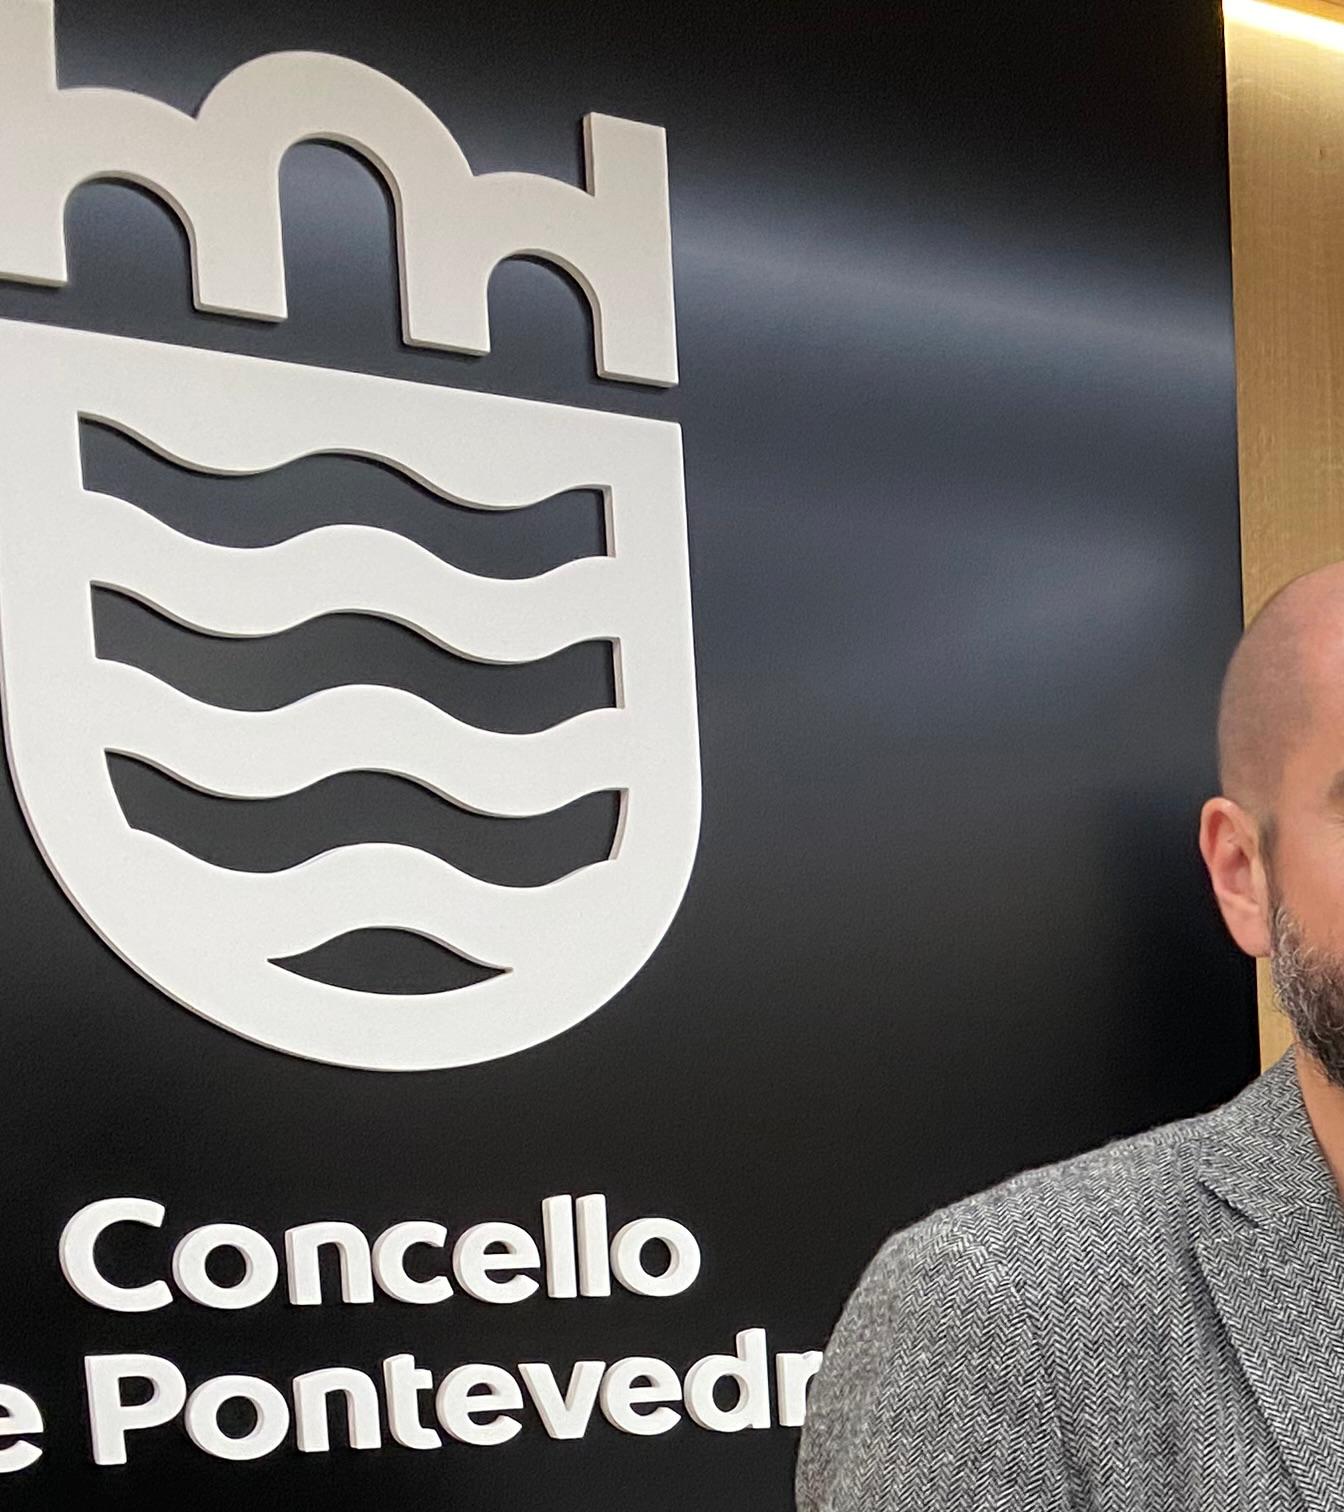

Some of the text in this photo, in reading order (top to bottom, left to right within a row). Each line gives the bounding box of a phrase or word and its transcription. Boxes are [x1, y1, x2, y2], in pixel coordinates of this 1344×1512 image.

[60, 1193, 701, 1312] Concello
[0, 1327, 823, 1474] e Pontevedr
